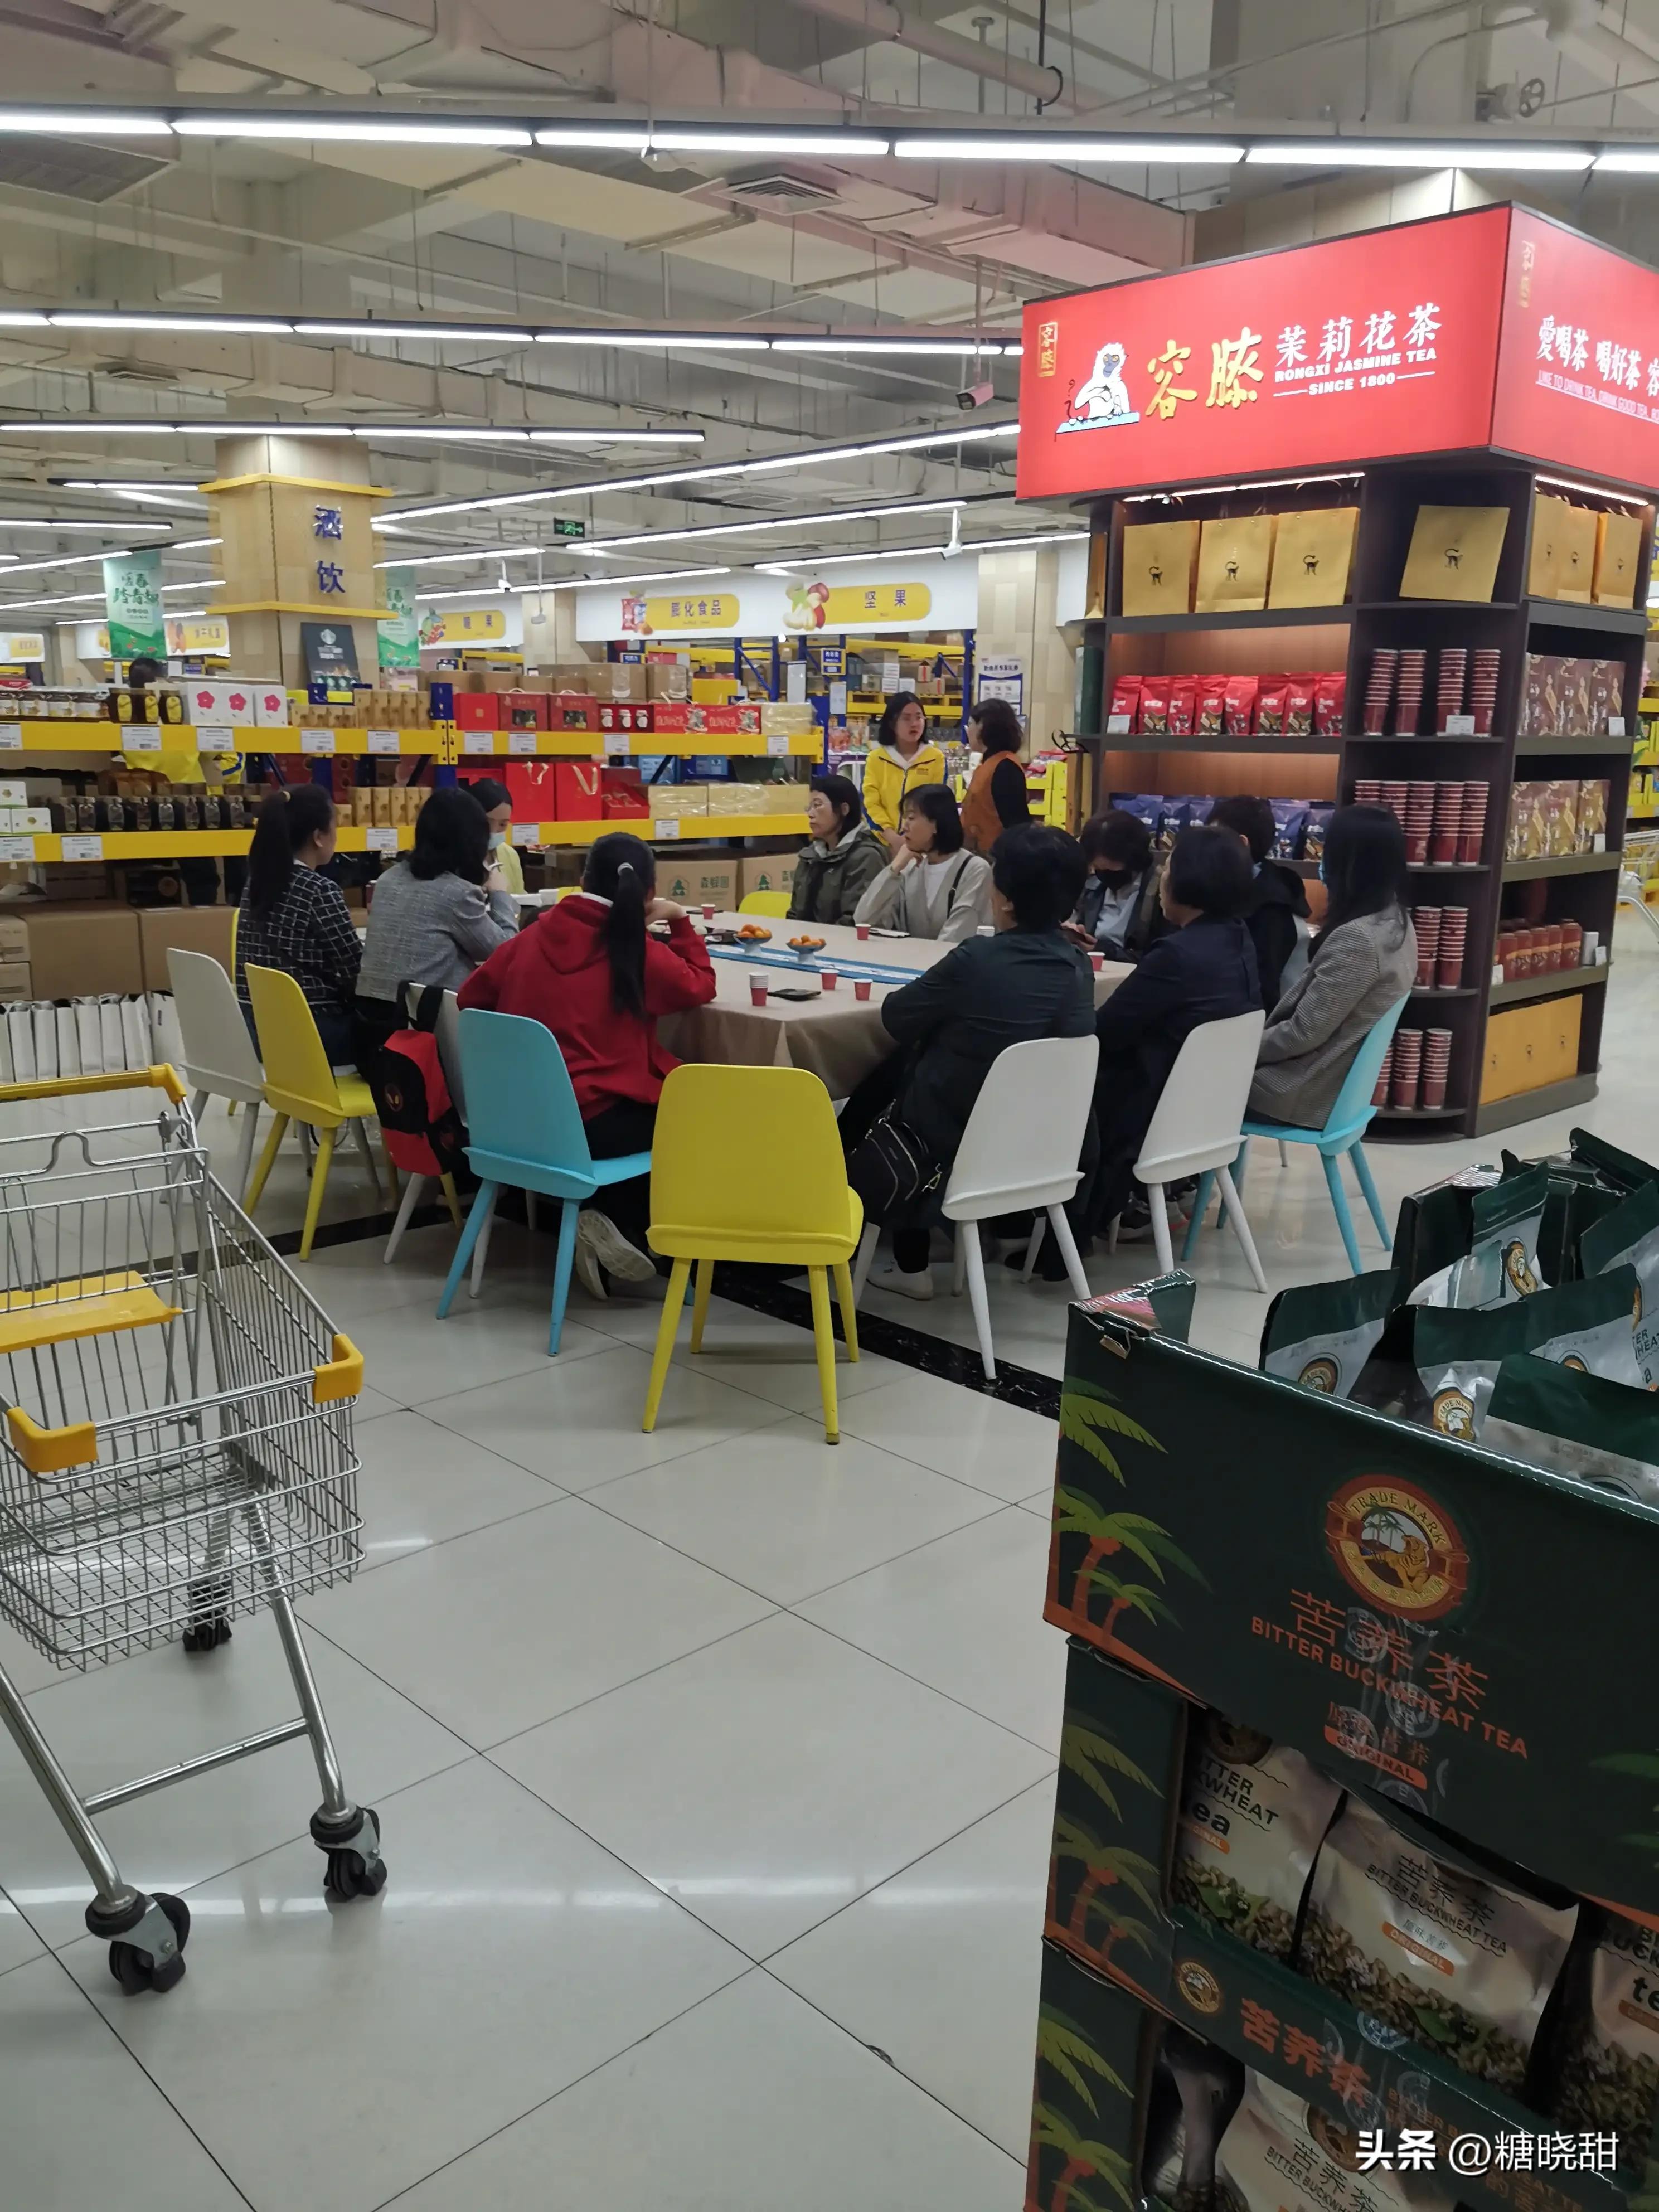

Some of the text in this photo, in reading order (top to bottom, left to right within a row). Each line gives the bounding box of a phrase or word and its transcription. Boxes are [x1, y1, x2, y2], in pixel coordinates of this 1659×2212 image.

[1275, 302, 1442, 367] 茉莉花茶
[1145, 326, 1264, 420] 容膝
[1275, 347, 1437, 383] RONGXI JASMINE TEA
[1308, 372, 1396, 395] SINCE 1800
[1595, 341, 1642, 391] 喝好茶
[313, 505, 346, 594] 酒饮
[671, 600, 721, 617] 膨化食品
[865, 589, 906, 609] 坚果
[1350, 1491, 1445, 1544] TRADE MARK
[1251, 1616, 1324, 1665] BITTER
[1481, 1721, 1529, 1760] TEA
[1367, 1863, 1506, 1953] BITTER BUCKWHEAT TEA
[1266, 2146, 1303, 2180] BITTER
